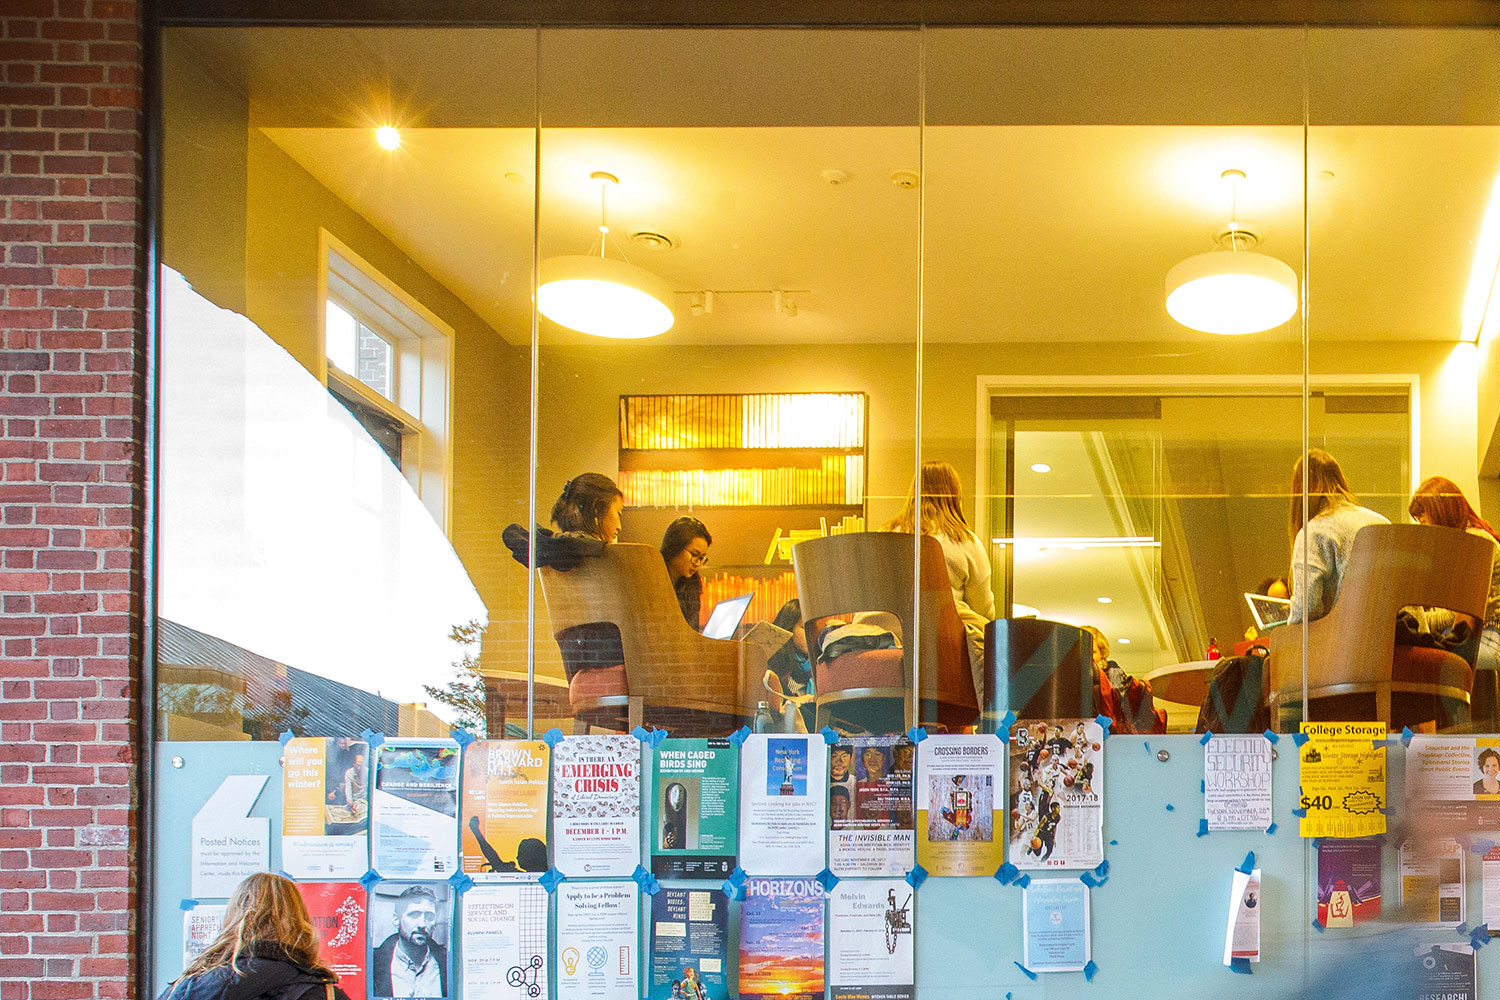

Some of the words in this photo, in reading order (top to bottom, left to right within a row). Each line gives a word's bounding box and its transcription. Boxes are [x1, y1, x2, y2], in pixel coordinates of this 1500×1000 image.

[1303, 725, 1342, 736] College
[1345, 725, 1385, 736] Storage
[289, 746, 318, 754] Where
[488, 749, 531, 759] BROWN
[660, 751, 686, 759] WHEN
[687, 751, 716, 759] CAGED
[934, 747, 962, 756] CROSSING
[963, 746, 989, 755] BORDERS
[307, 758, 322, 767] you
[488, 758, 543, 768] HARVARD
[660, 760, 685, 768] BIRDS
[687, 760, 707, 768] SING
[1208, 754, 1271, 771] SECURITY
[288, 770, 300, 778] go
[561, 763, 632, 778] EMERGING
[288, 780, 321, 788] winter?
[1206, 772, 1270, 788] WORKSHOP
[575, 779, 619, 793] CRISIS
[1066, 794, 1099, 802] 2017-18
[1301, 795, 1332, 810] $40
[201, 837, 226, 846] Posted
[230, 838, 260, 846] Notices
[750, 880, 824, 896] HORIZONS
[575, 902, 597, 910] Solving
